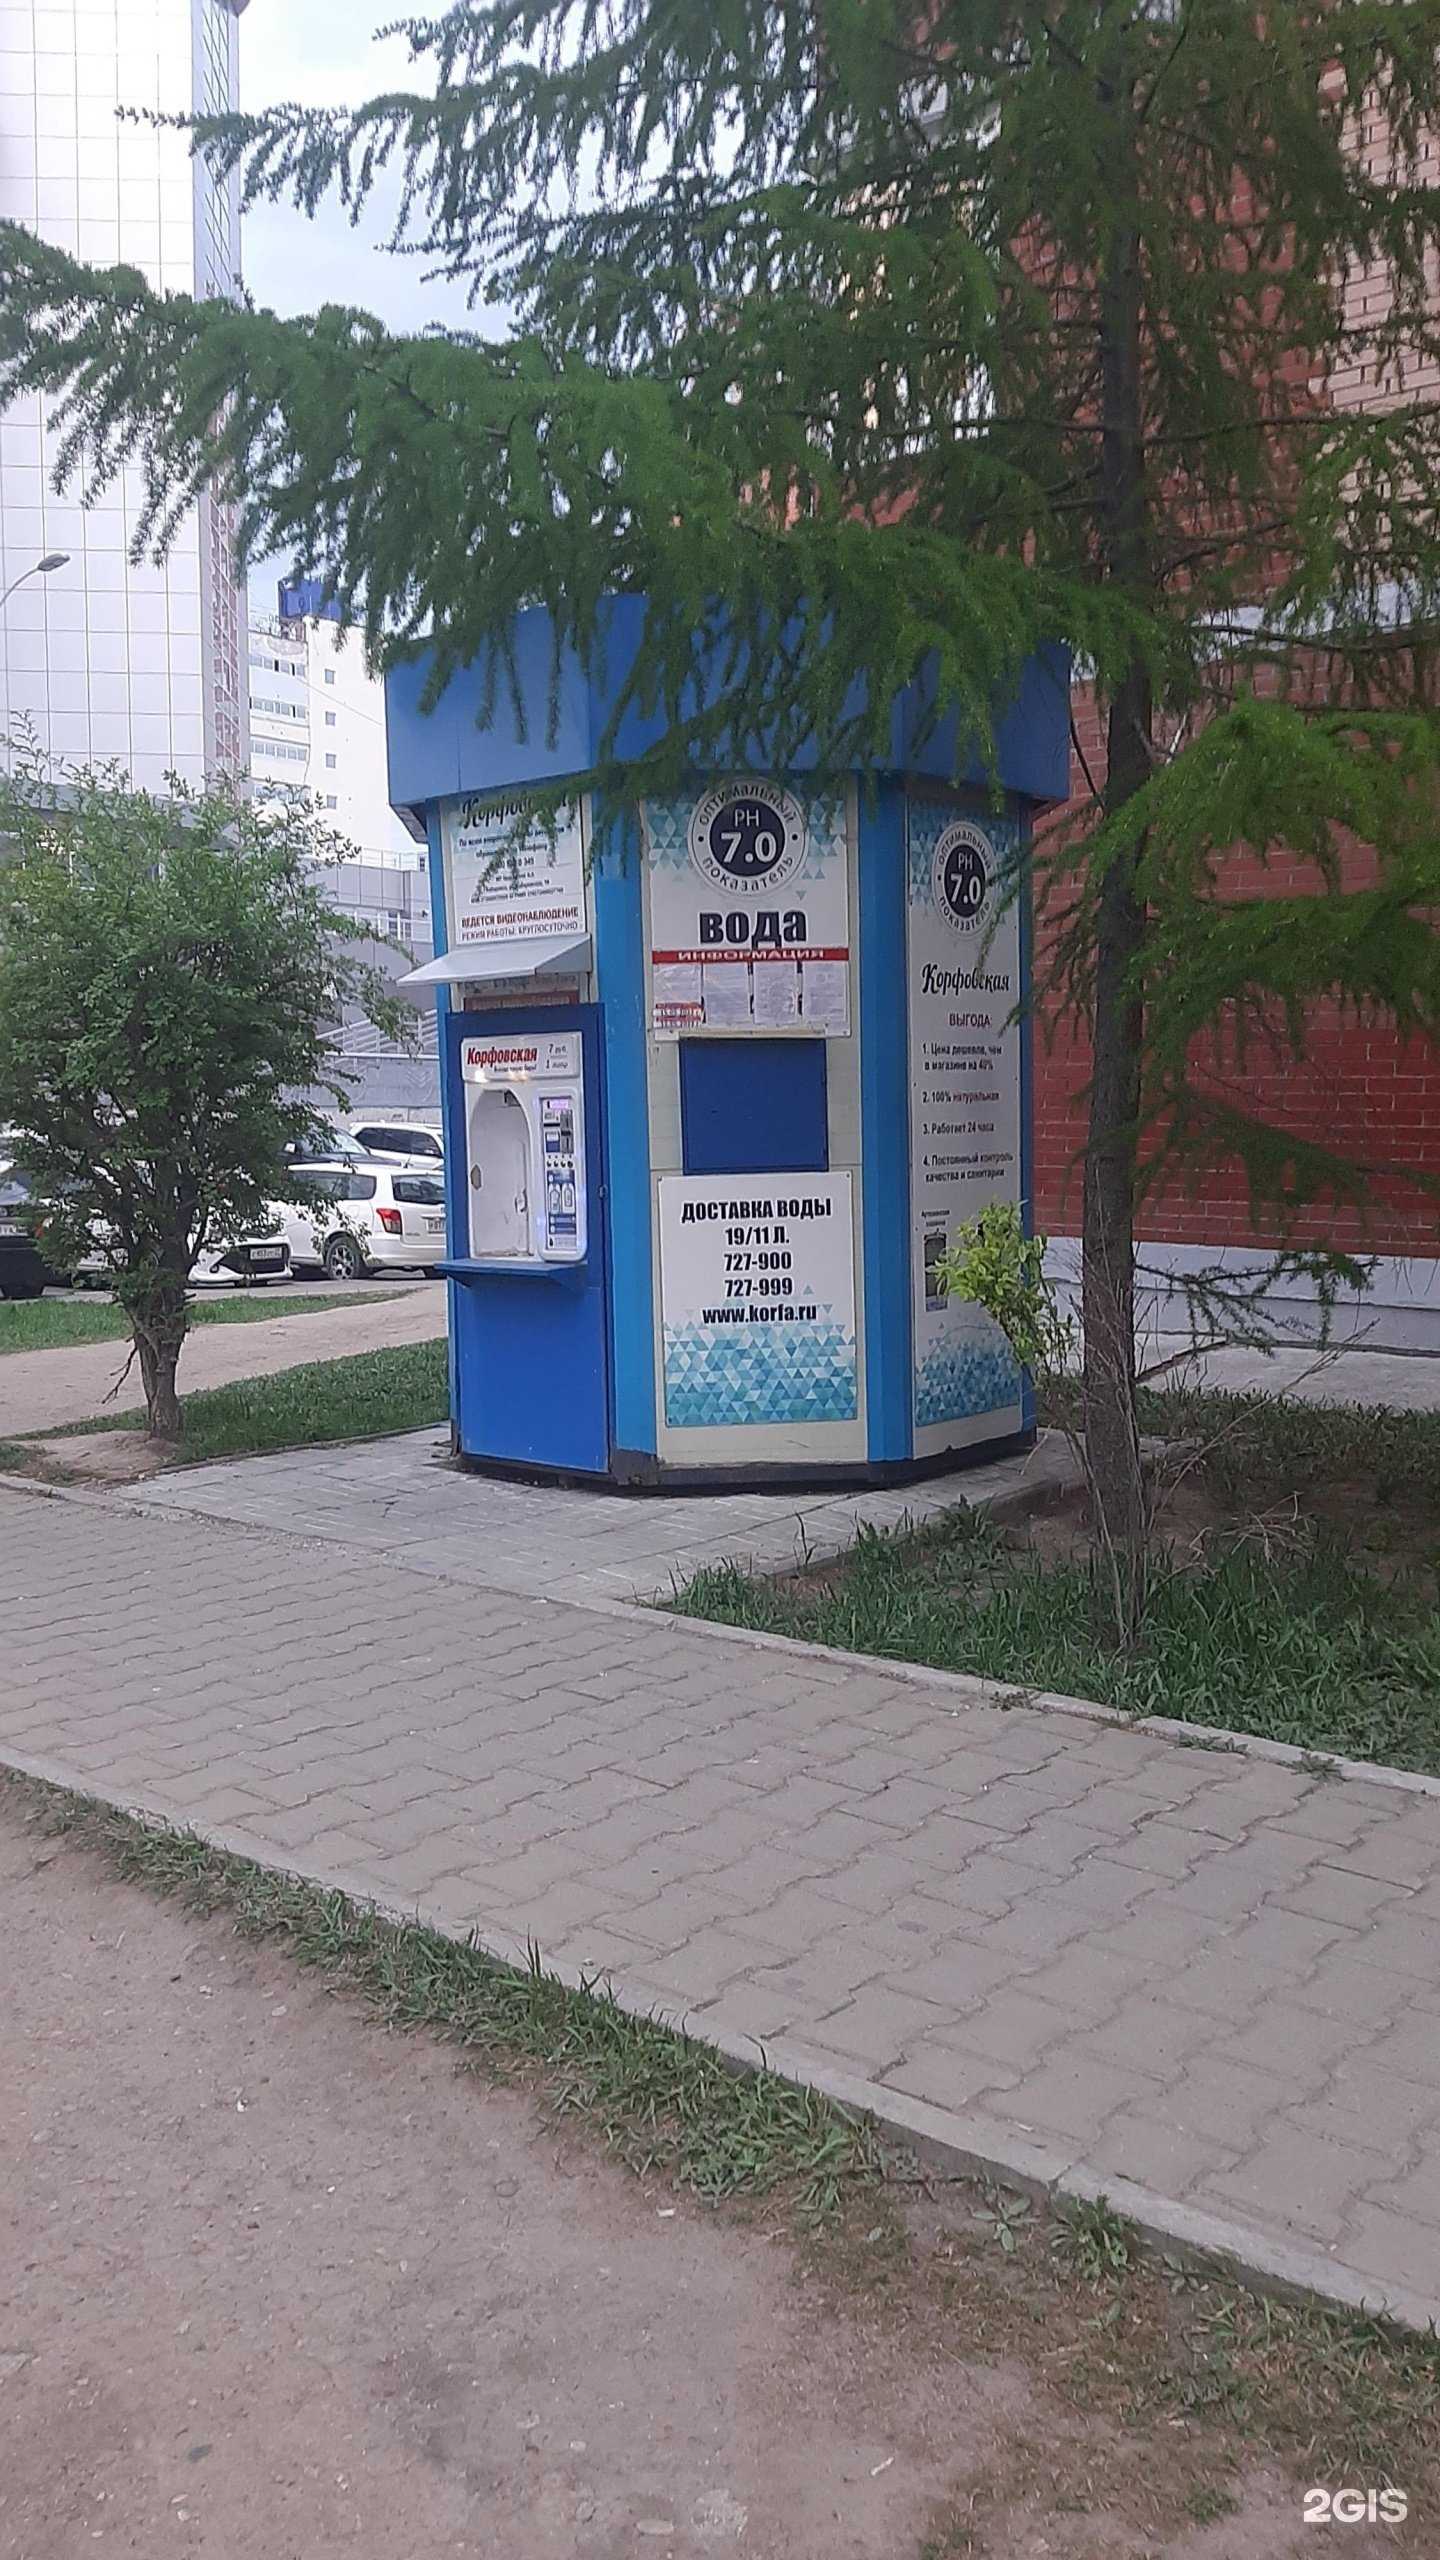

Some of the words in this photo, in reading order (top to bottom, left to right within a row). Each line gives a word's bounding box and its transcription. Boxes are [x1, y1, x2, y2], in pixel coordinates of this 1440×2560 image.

[721, 831, 777, 863] 7.0
[950, 872, 980, 904] 7.0
[496, 906, 579, 924] ВИДЕОНАБЛЮДЕНИЕ
[461, 928, 485, 941] РЕЖИМ
[518, 920, 578, 934] КРУГЛОСУТОЧНО
[678, 950, 824, 960] ИНФОРМАЦИЯ
[467, 1046, 538, 1068] Корфовская
[931, 1043, 950, 1056] Цена
[932, 1061, 967, 1071] магазине
[968, 1060, 977, 1070] на
[931, 1091, 952, 1102] 100%
[953, 1092, 1000, 1104] натуральная
[923, 1123, 930, 1135] 3.
[931, 1122, 966, 1134] Работает
[967, 1121, 976, 1133] 24
[923, 1155, 931, 1166] 4.
[681, 1200, 773, 1223] ДОСТАВКА
[777, 1198, 832, 1220] ВОДЫ
[725, 1226, 769, 1246] 19/11
[724, 1251, 792, 1272] 727-900
[724, 1277, 793, 1297] 727-999
[702, 1303, 817, 1324] www.korfa.ru
